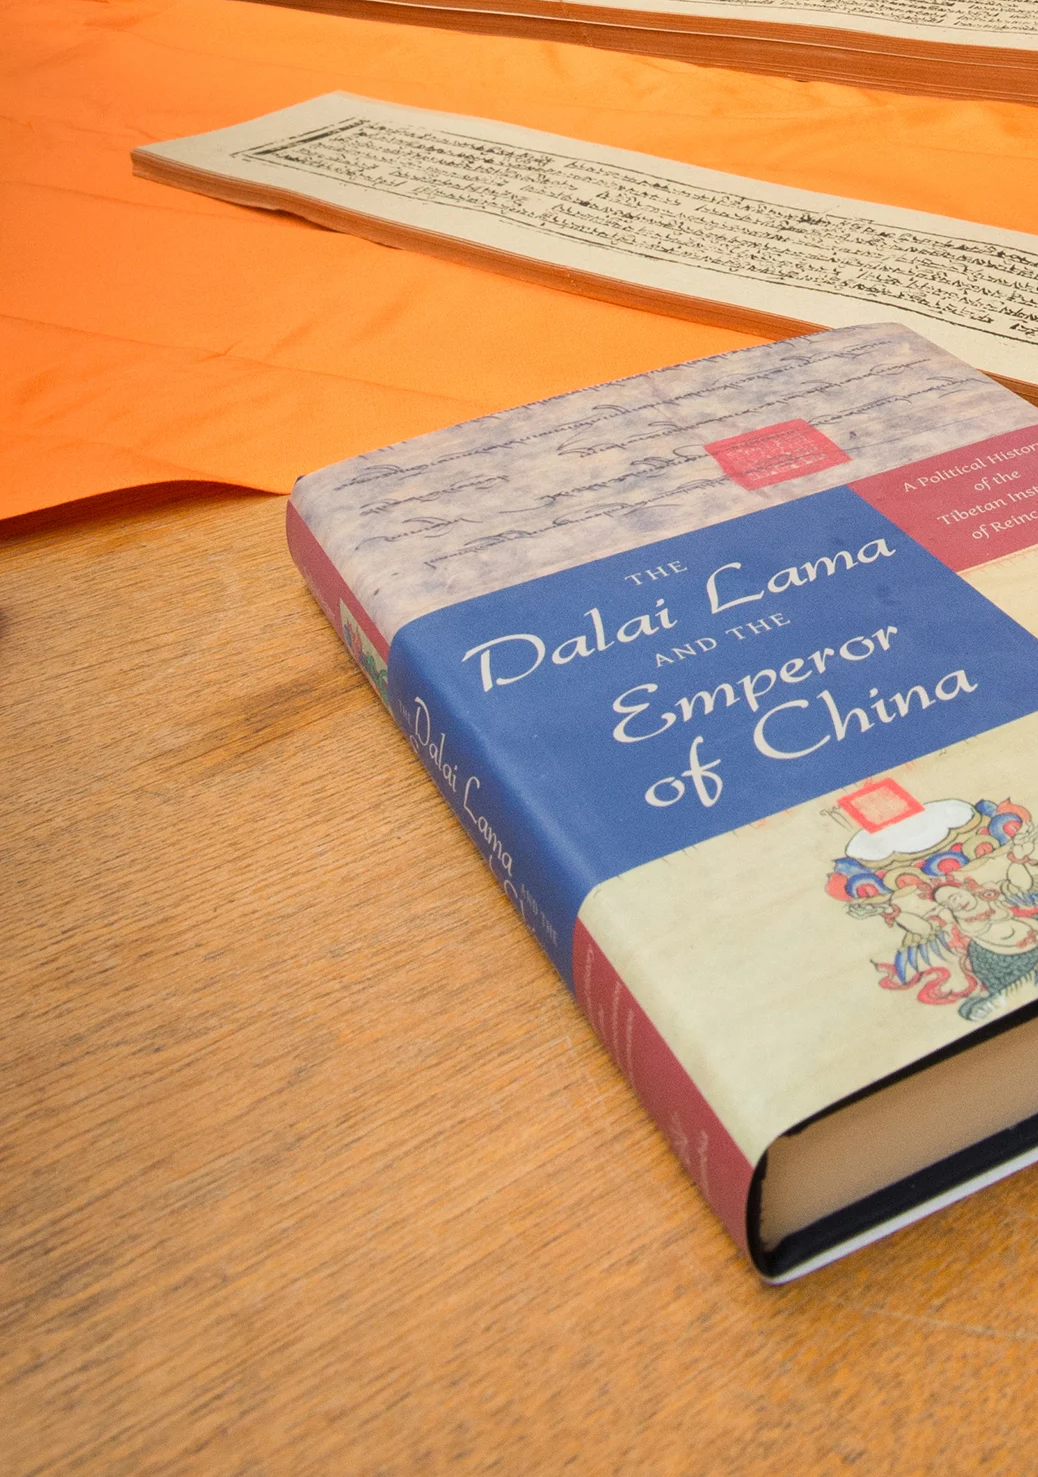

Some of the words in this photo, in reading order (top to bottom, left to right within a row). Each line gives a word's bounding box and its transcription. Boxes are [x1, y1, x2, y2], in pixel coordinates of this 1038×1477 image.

[904, 482, 916, 493] A
[917, 458, 987, 488] Political
[974, 477, 992, 491] of
[992, 470, 1021, 485] the
[937, 497, 1008, 525] Tibetan
[972, 524, 990, 540] of
[624, 560, 688, 586] THE
[462, 598, 678, 693] Dalai
[706, 538, 896, 614] Lama
[655, 637, 718, 668] AND
[725, 612, 791, 640] THE
[612, 625, 898, 743] Emperor
[645, 735, 723, 808] of
[753, 670, 978, 759] China
[415, 696, 457, 793] Dalai
[463, 776, 513, 877] Lama
